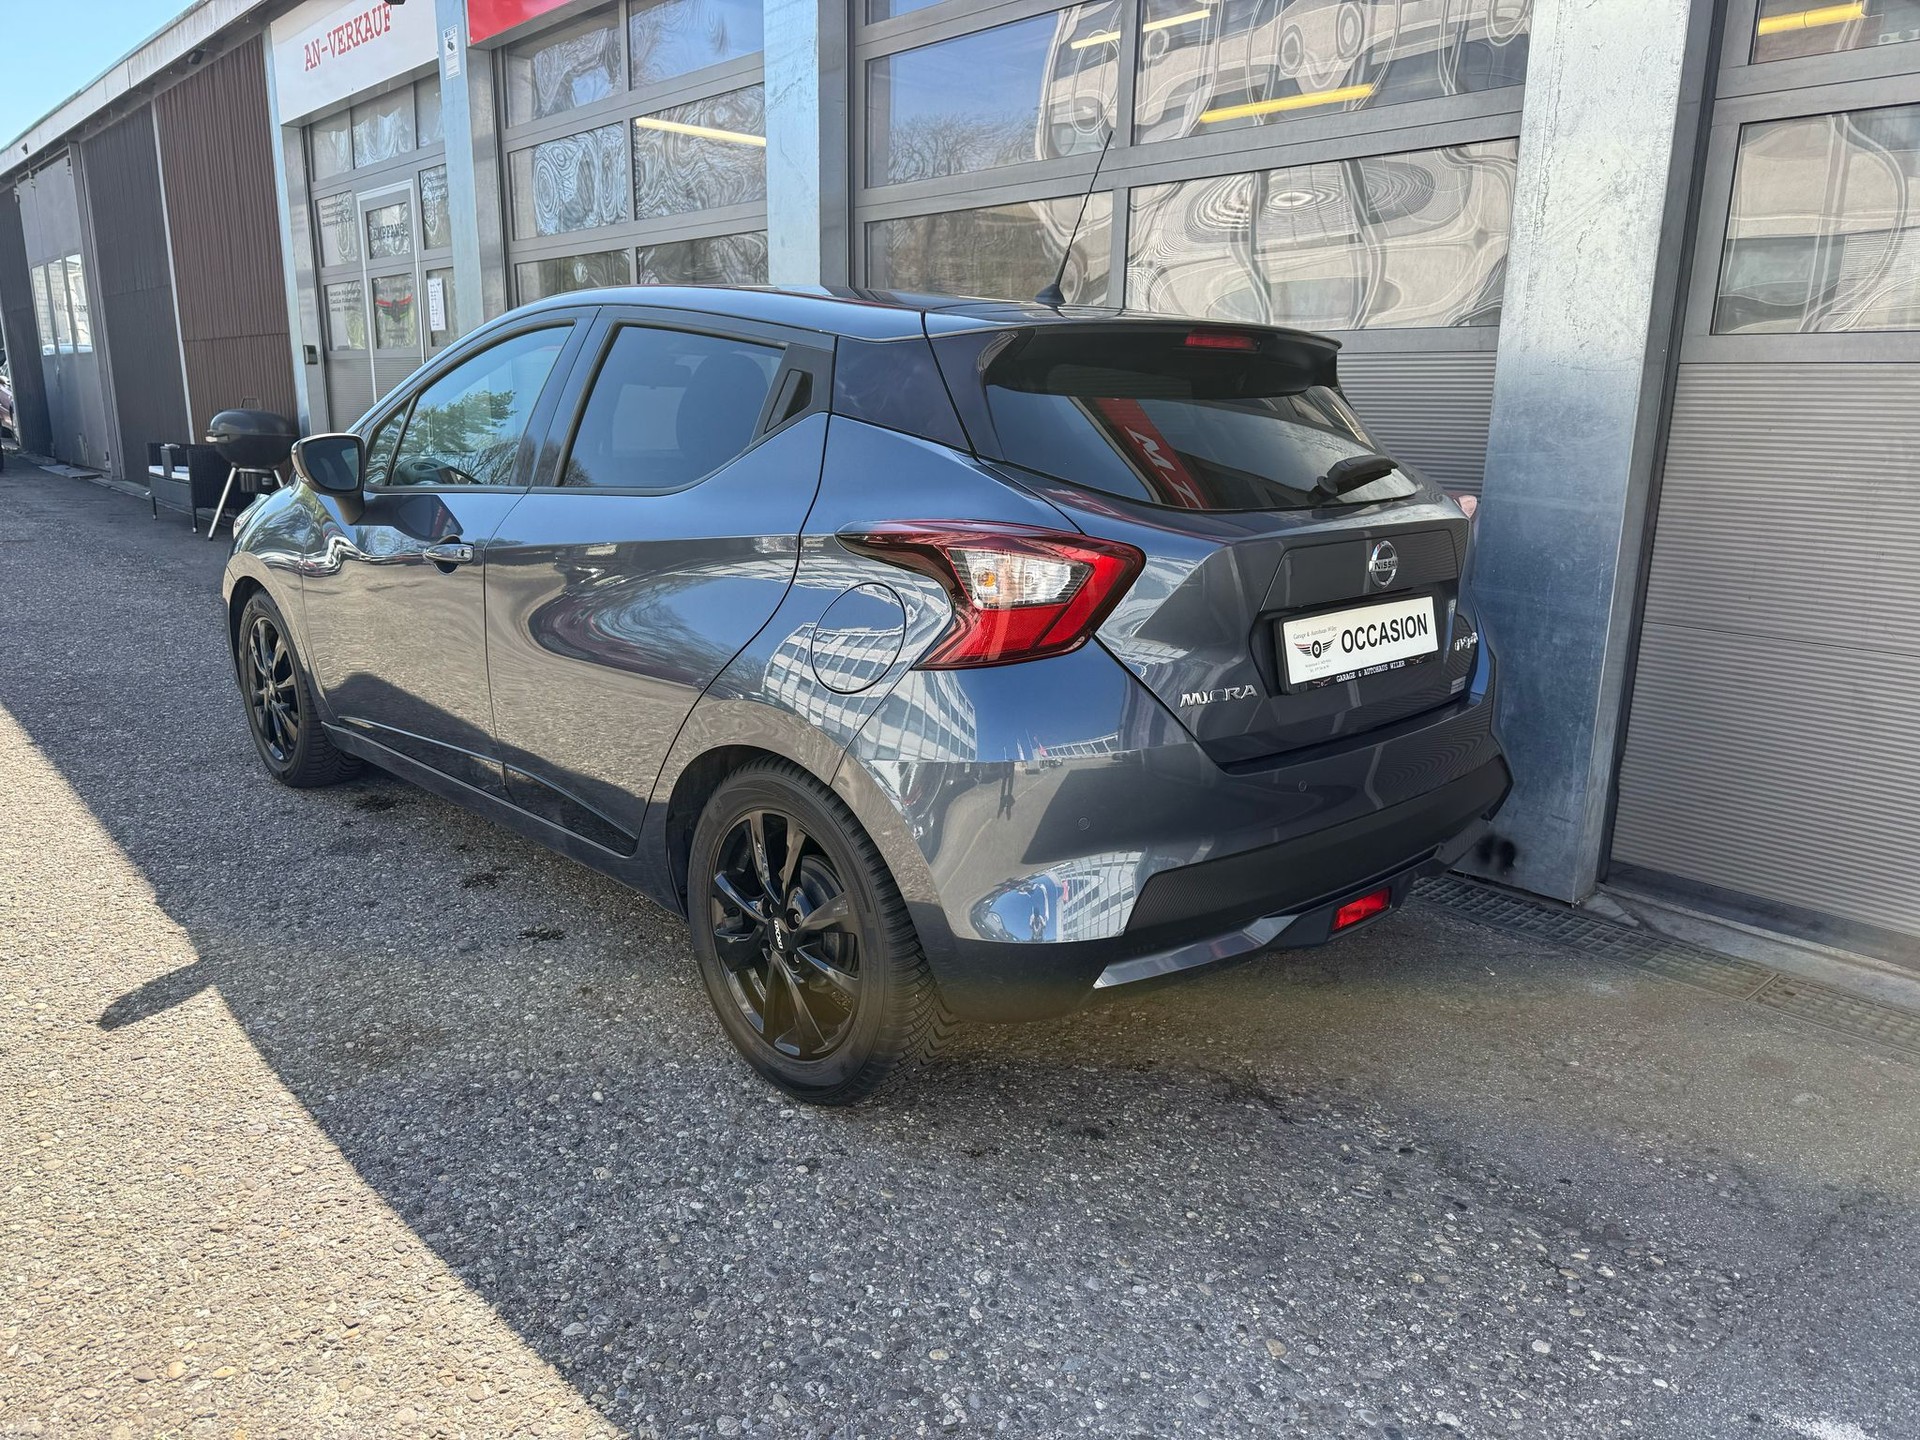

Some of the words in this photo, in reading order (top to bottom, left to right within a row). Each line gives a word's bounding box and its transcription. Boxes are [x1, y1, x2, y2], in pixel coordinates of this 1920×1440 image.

[305, 3, 392, 71] AN-VERKAUF
[1341, 613, 1428, 653] OCCASION
[1336, 671, 1356, 683] GARAGE
[1363, 663, 1389, 676] AUTOHAUS
[1389, 660, 1406, 669] WILER
[1180, 684, 1258, 707] MICRA
